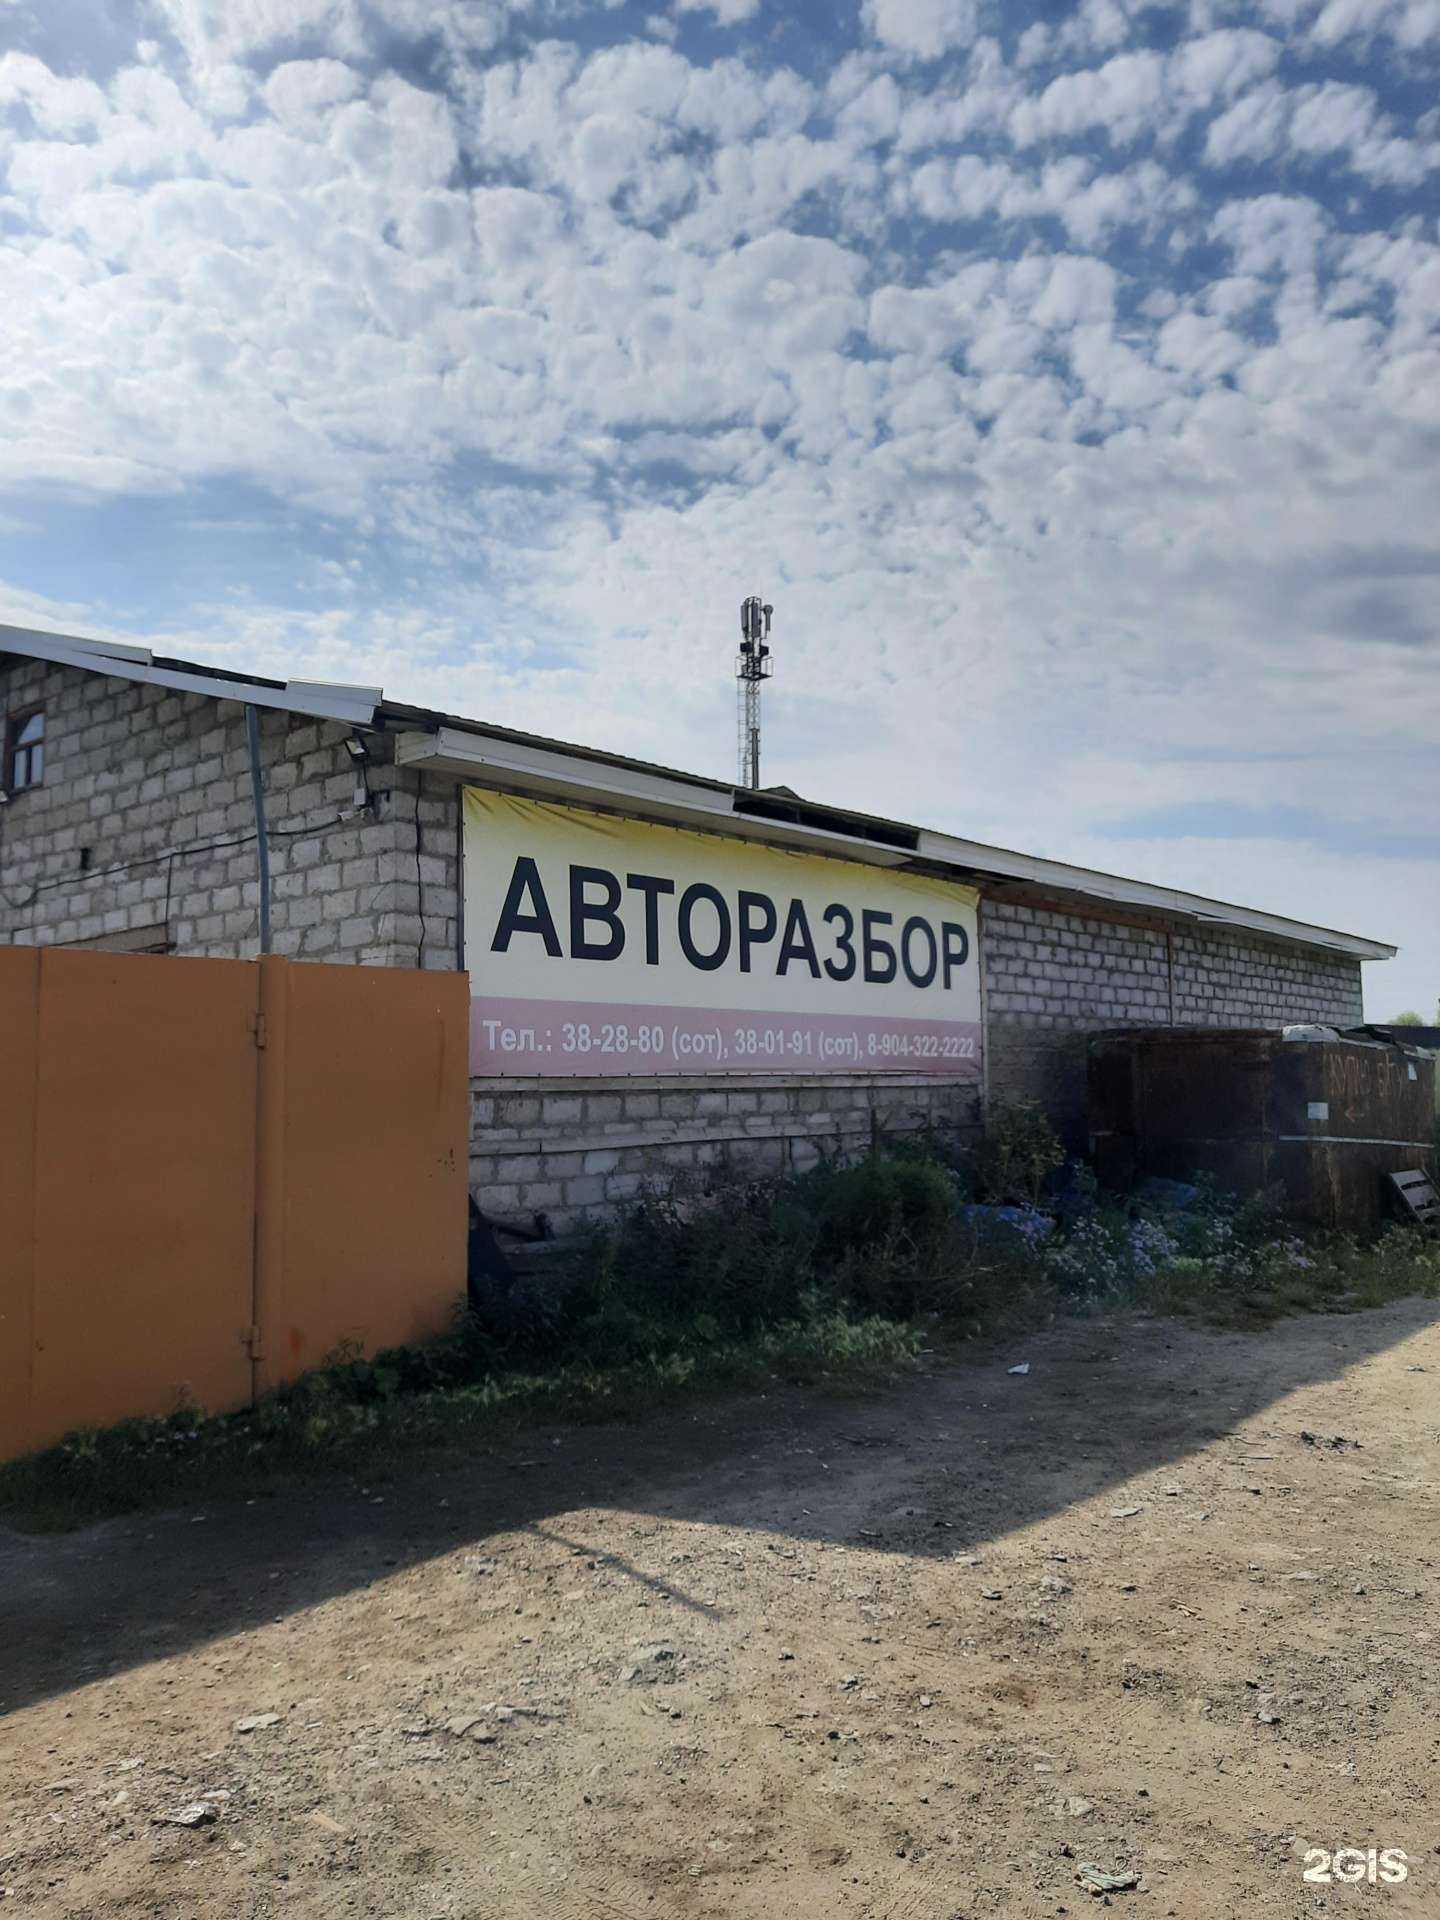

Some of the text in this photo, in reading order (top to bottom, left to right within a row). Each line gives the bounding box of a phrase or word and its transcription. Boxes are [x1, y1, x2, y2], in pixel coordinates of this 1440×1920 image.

[490, 855, 969, 990] АВТОРАЗБОР
[482, 1019, 974, 1061] Тел.: 38-28-80 (сот), 38-01-91 (сот), 8-904-322-2222
